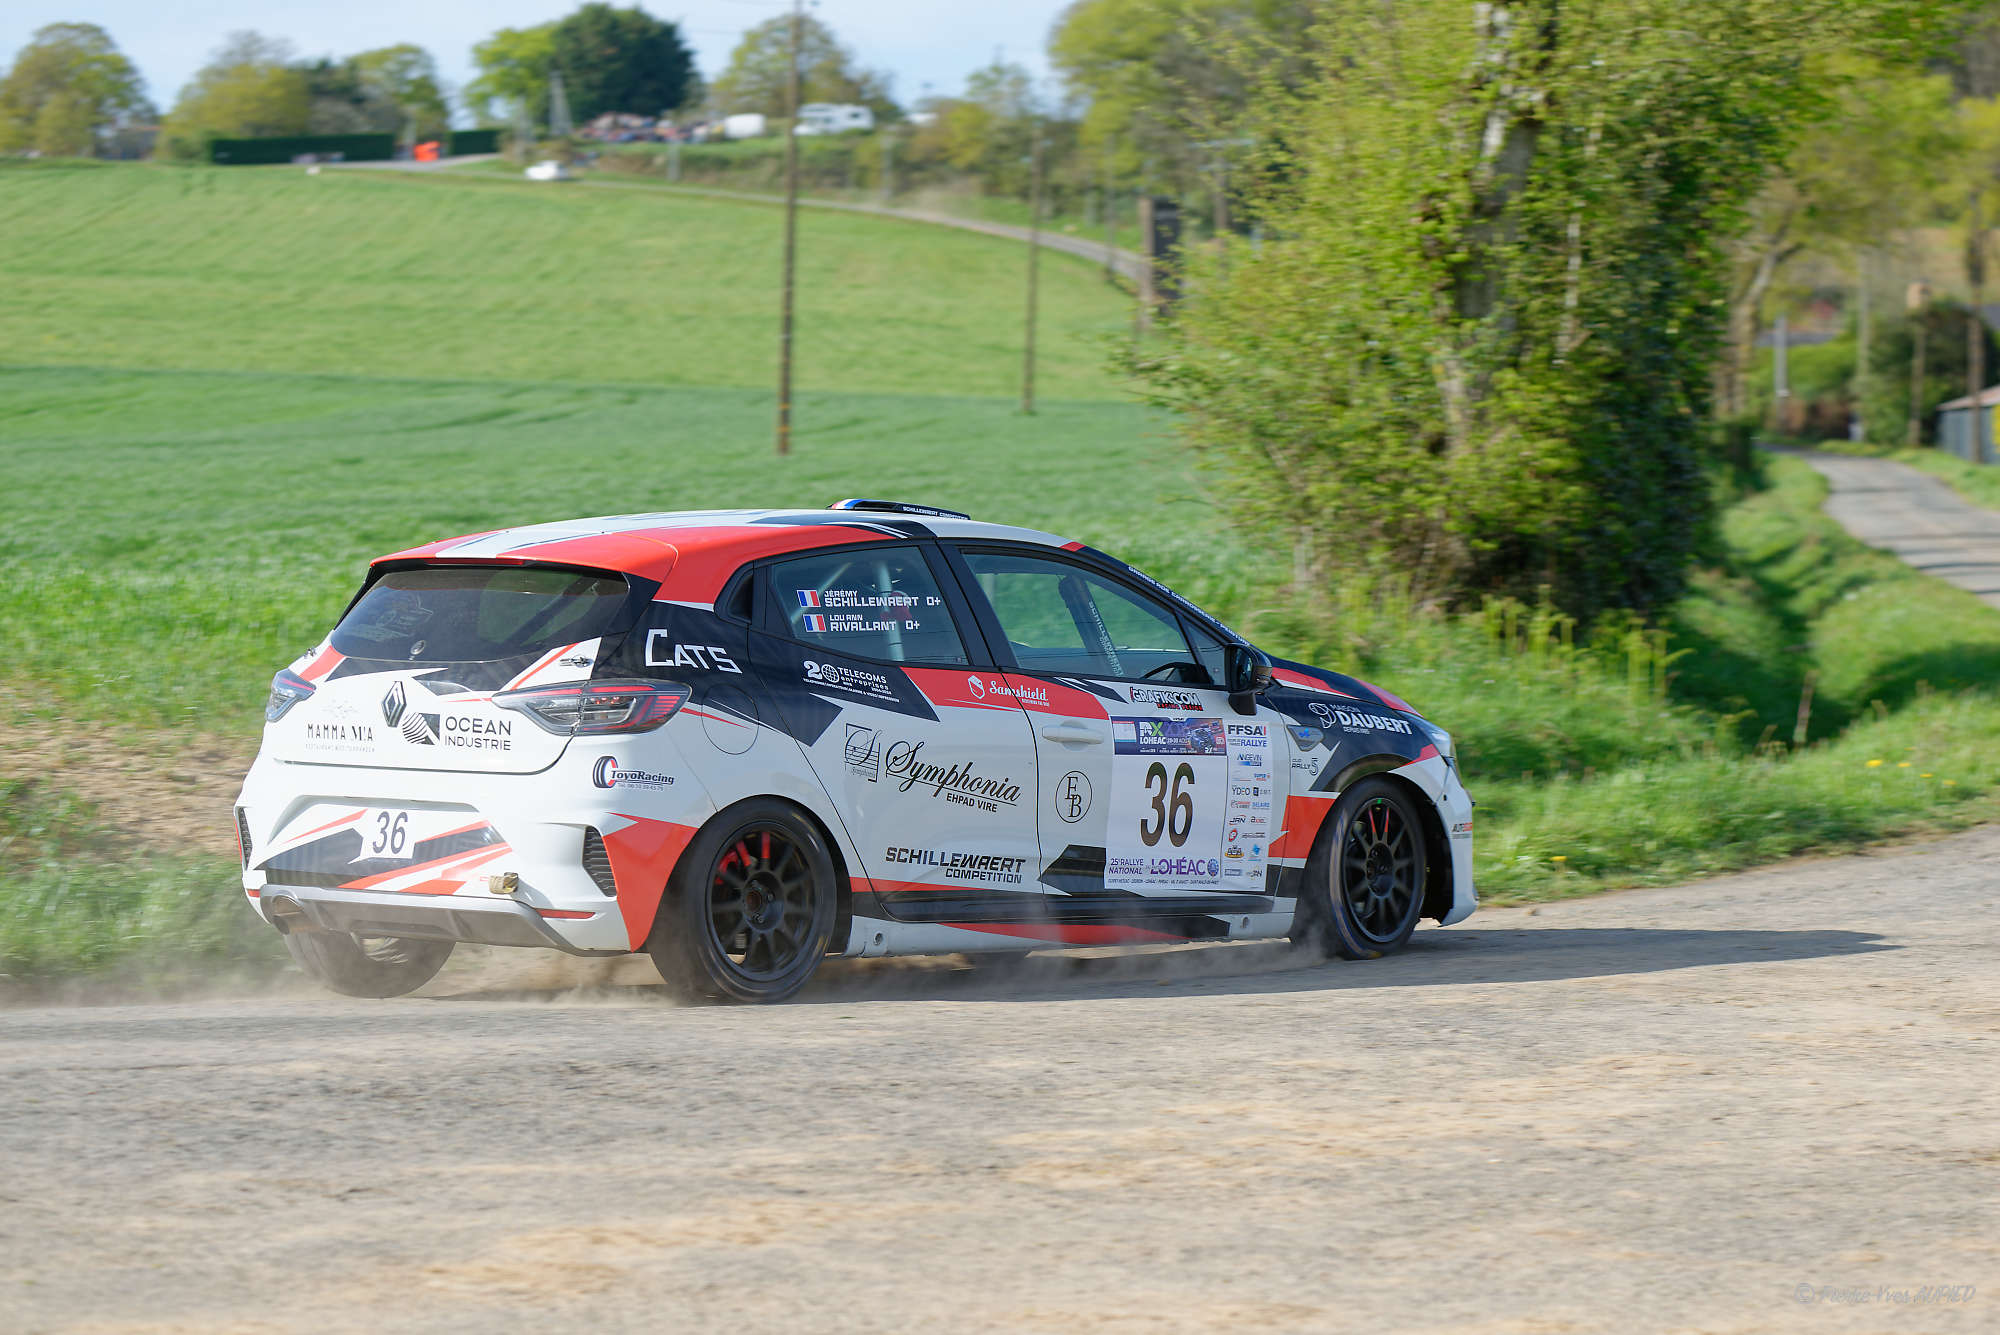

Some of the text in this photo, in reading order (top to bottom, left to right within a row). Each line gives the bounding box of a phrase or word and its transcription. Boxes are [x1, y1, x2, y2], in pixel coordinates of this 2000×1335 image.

[824, 590, 858, 598] JÉRÉMY
[824, 596, 919, 607] SCHILLEWAERT
[830, 621, 897, 632] RIVALLANT
[838, 666, 887, 684] TELECOMS
[840, 676, 889, 690] entreprises
[445, 716, 511, 736] OCEAN
[1228, 724, 1263, 736] FFSA
[1335, 710, 1412, 735] DAUBERT
[308, 723, 346, 740] MAMMA
[444, 735, 511, 751] INDUSTRIE
[1140, 736, 1167, 745] LOHEAC
[1240, 739, 1267, 747] RALLYE
[611, 770, 675, 785] ToyoRacing
[886, 741, 1022, 802] Symphonia
[946, 792, 998, 813] EHPAD VIRE
[1140, 761, 1196, 848] 36
[372, 811, 409, 855] 36
[885, 847, 1026, 873] SCHILLEWAERT
[1121, 858, 1144, 866] RALLYE
[1150, 857, 1206, 876] LOHÉAC
[945, 868, 1022, 884] COMPETITION
[1108, 867, 1143, 875] NATIONAL
